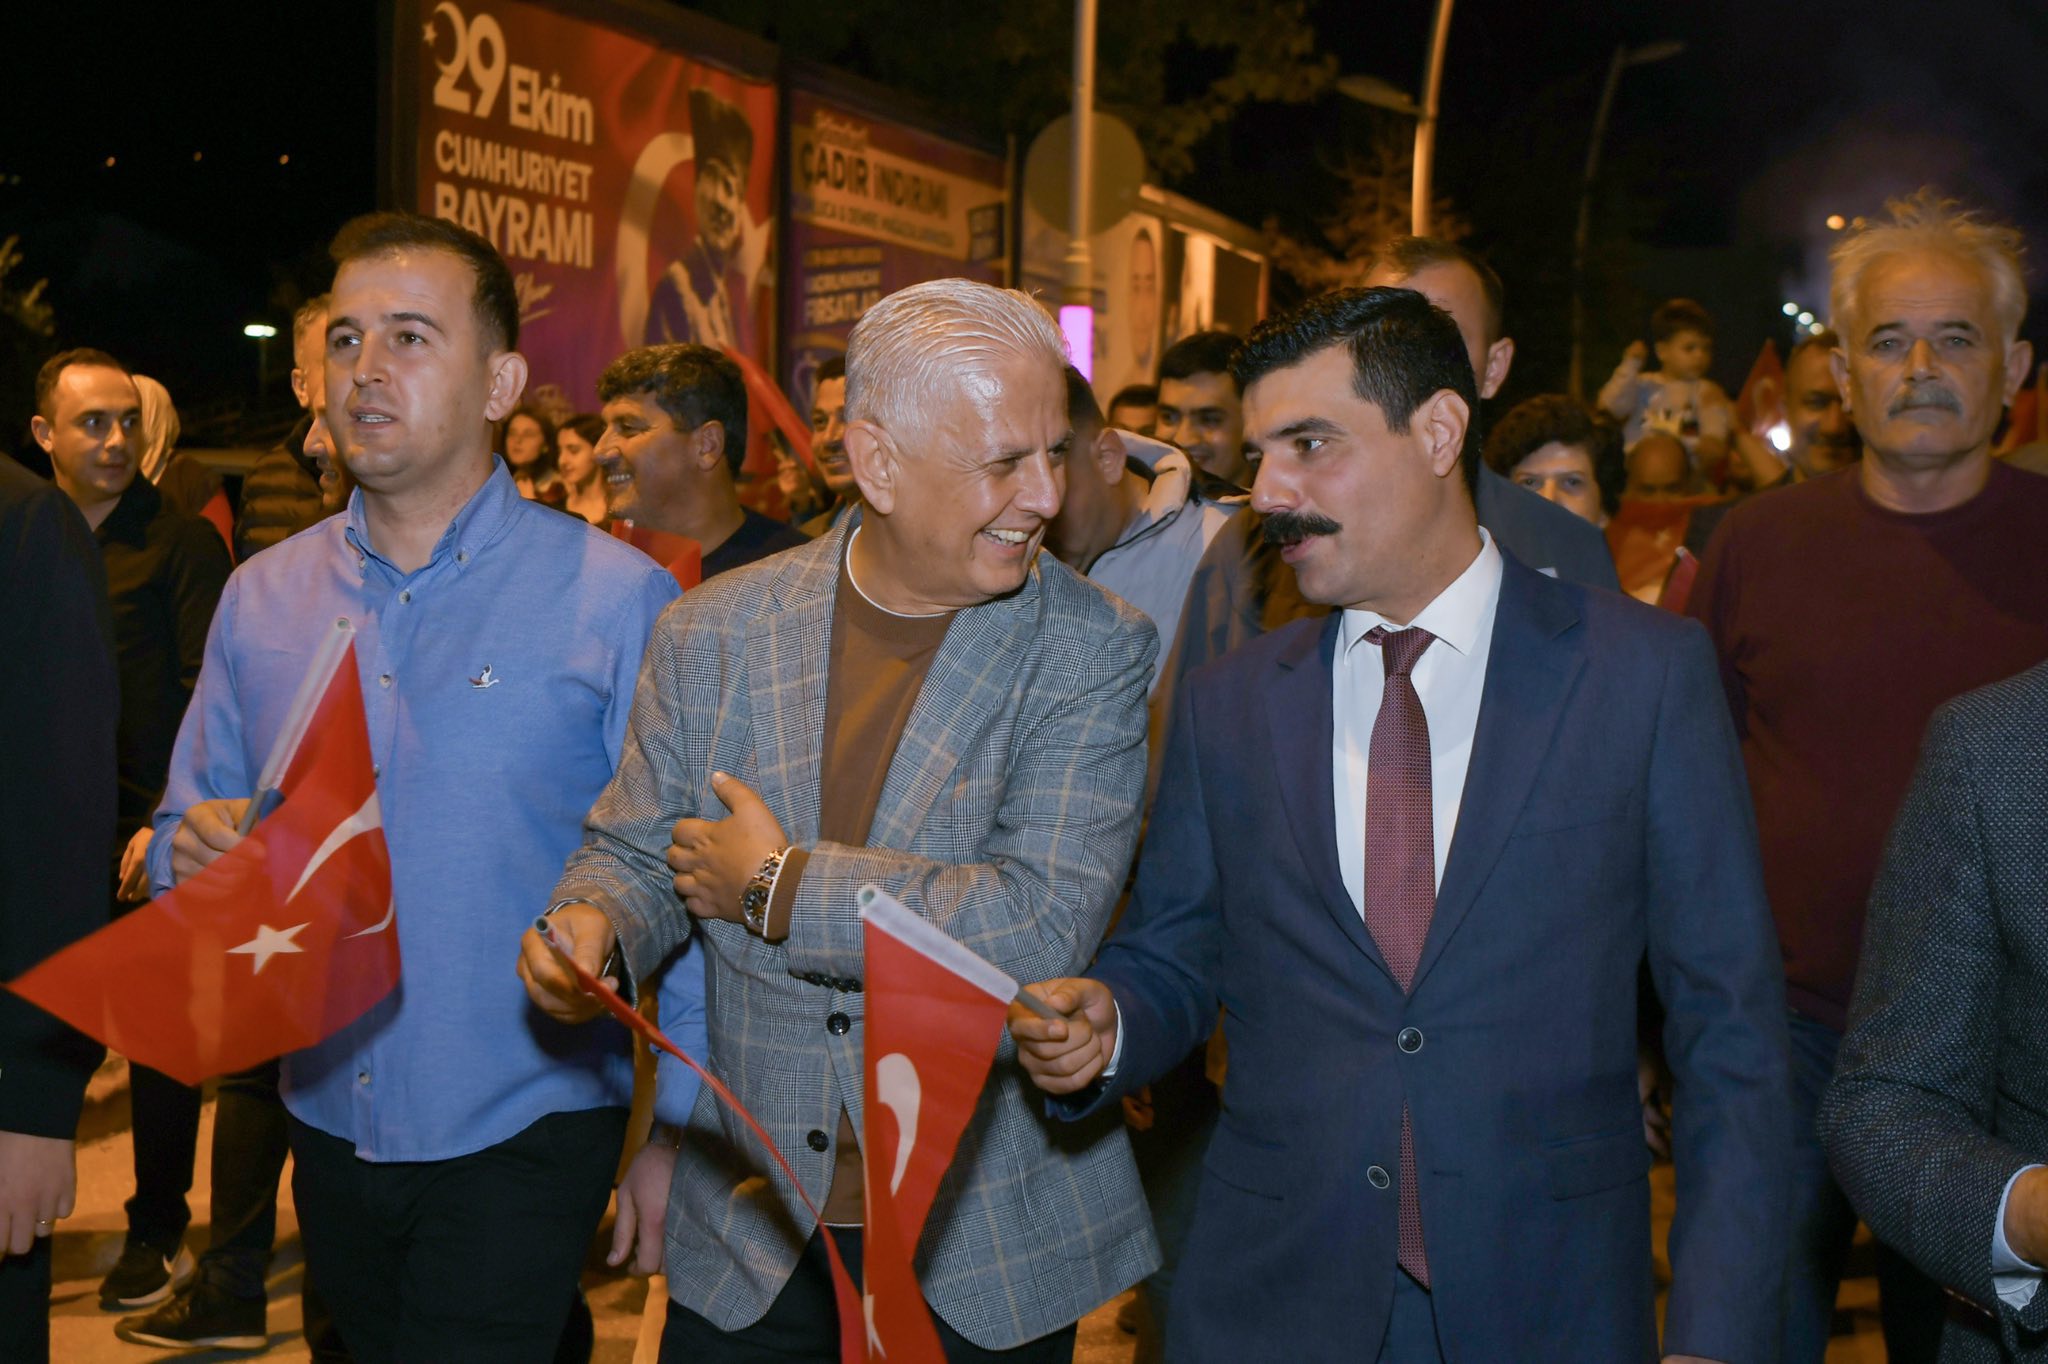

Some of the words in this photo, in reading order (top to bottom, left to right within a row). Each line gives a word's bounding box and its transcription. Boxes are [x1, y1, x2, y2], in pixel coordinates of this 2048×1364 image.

[433, 2, 507, 119] 29
[509, 64, 595, 146] Ekim
[435, 182, 594, 269] BAYRAMI
